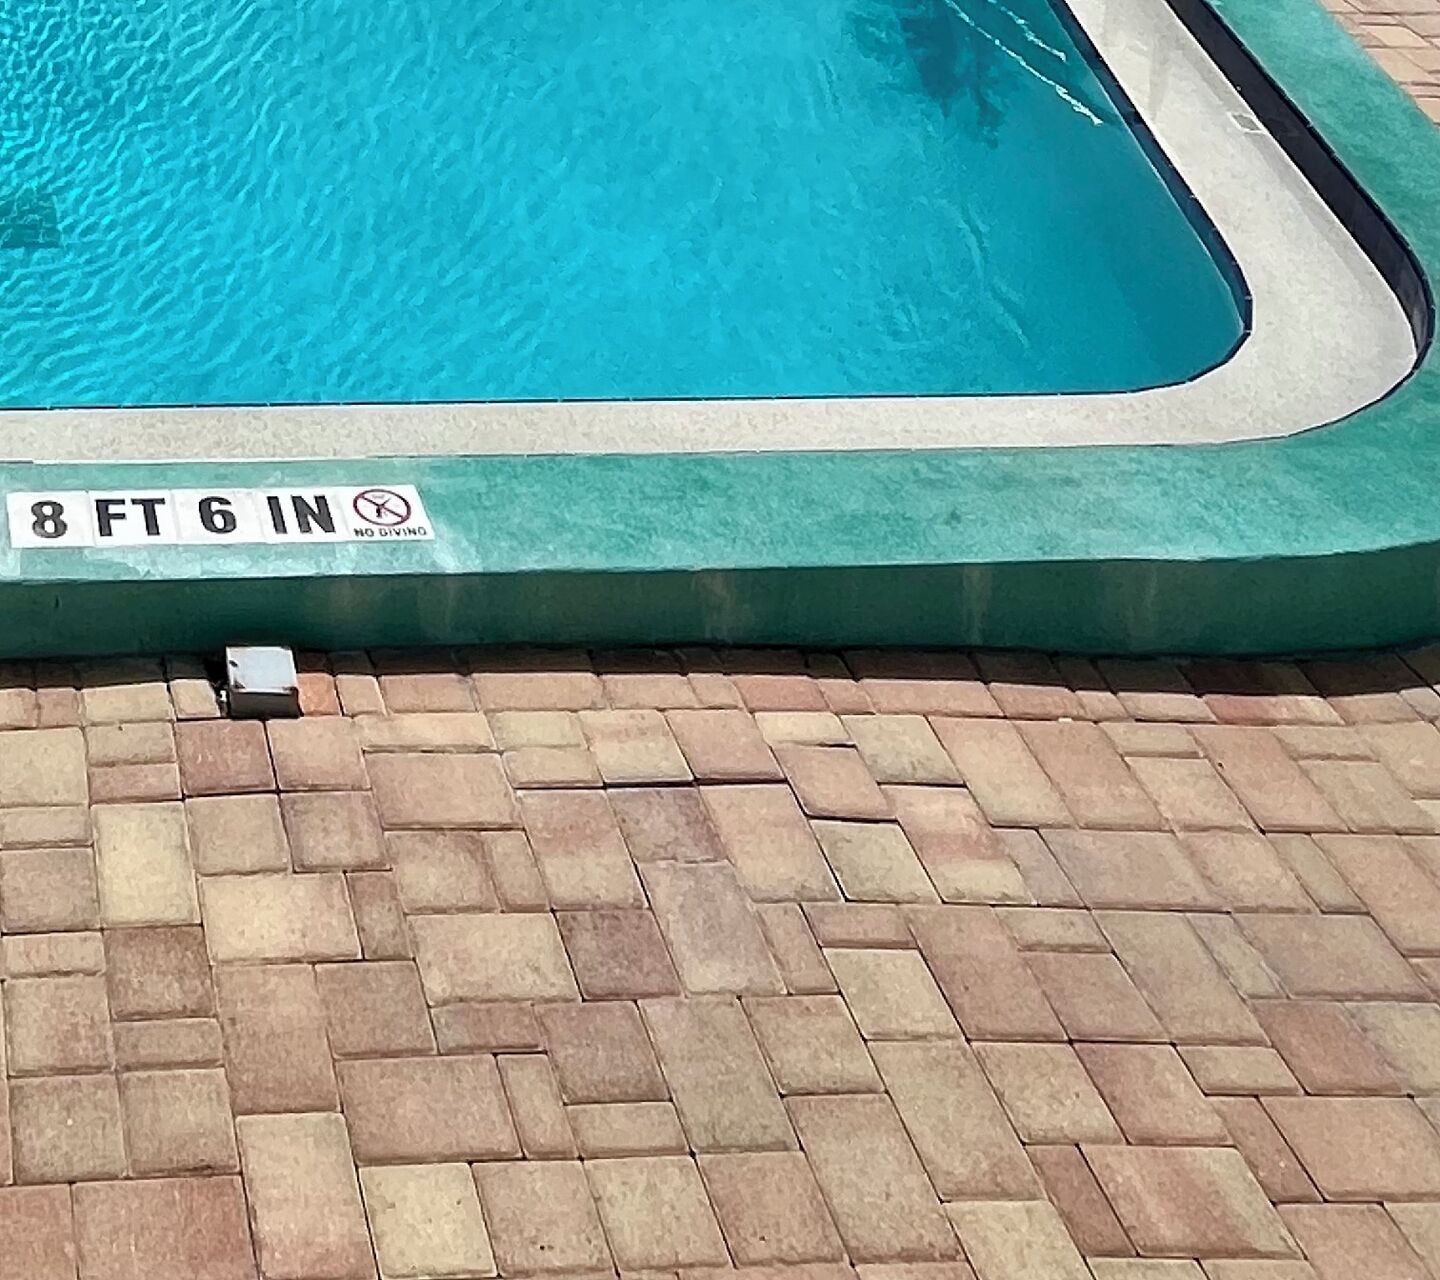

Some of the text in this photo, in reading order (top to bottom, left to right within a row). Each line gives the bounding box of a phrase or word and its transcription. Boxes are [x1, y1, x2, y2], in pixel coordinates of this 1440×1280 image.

[31, 494, 336, 538] 8 FT 6 IN
[353, 526, 427, 537] NO DIVING
